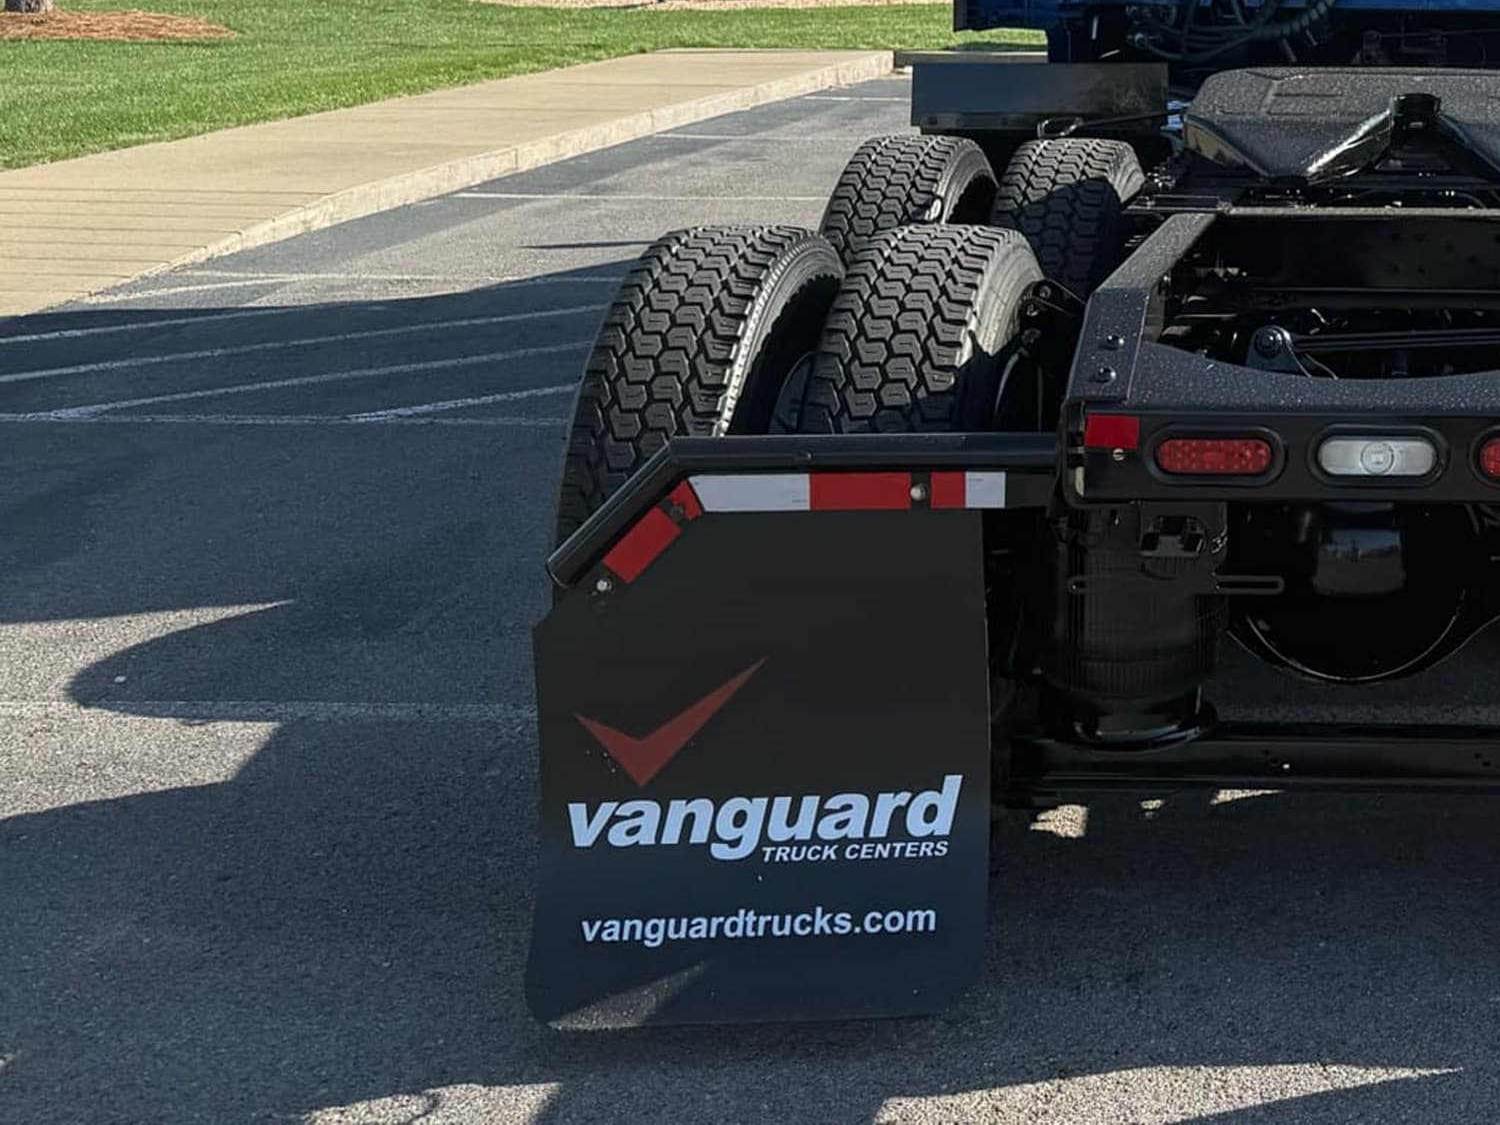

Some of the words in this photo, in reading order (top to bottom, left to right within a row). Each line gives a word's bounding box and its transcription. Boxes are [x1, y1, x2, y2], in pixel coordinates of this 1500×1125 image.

[567, 774, 964, 861] vanguard
[761, 844, 839, 863] TRUCK
[844, 840, 949, 860] CENTERS
[581, 905, 937, 948] vanguardtrucks.com
